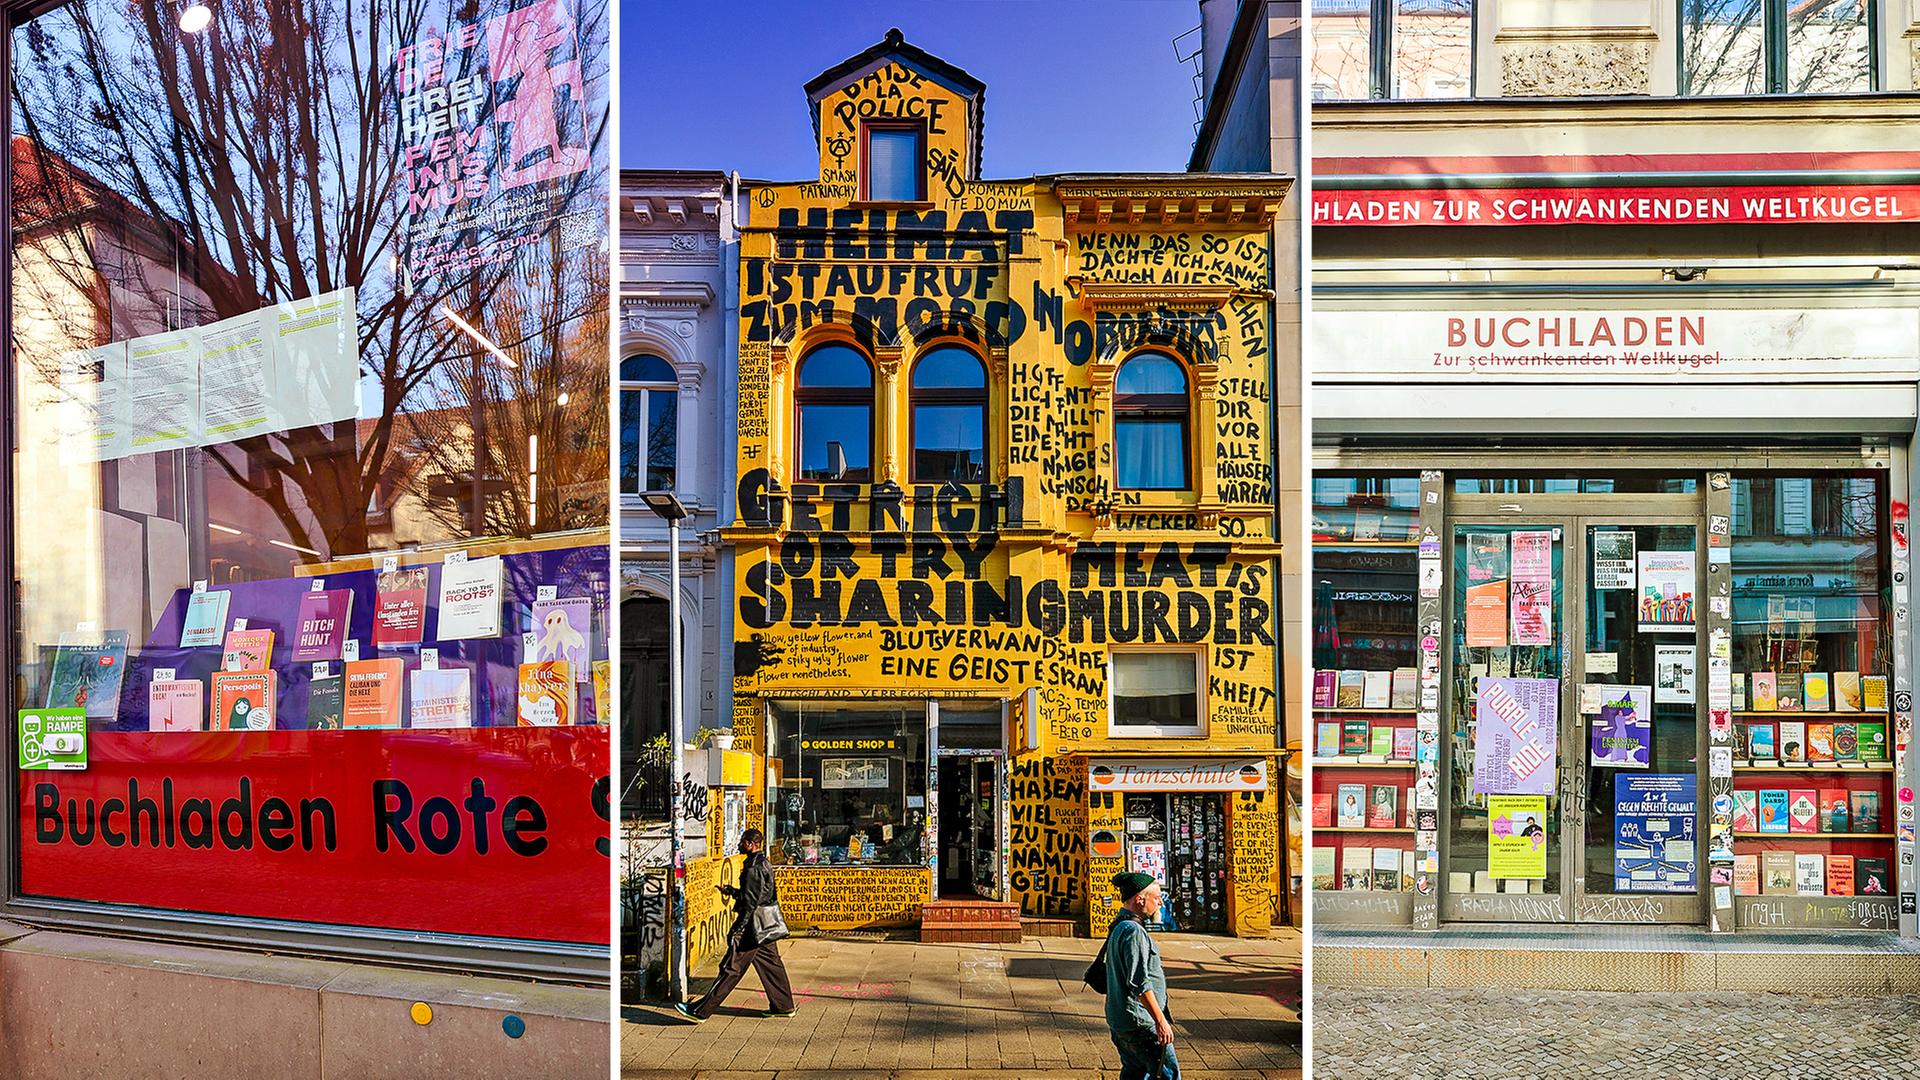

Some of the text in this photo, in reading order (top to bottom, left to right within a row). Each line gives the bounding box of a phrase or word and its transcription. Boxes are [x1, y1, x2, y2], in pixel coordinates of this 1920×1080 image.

[397, 24, 478, 67] FRIE
[401, 73, 484, 120] FREI
[876, 83, 903, 99] LA
[402, 97, 484, 142] HEIT
[834, 97, 950, 135] POLICE
[405, 126, 487, 168] FEM
[408, 151, 488, 192] INIS
[822, 167, 857, 182] SMASH
[409, 175, 489, 215] MUS
[797, 183, 858, 202] PATRIARCHY
[967, 183, 1024, 198] ROMANI
[972, 197, 1033, 213] DOMUM
[1431, 199, 1482, 221] ZUR
[1492, 197, 1731, 222] SCHWANKENDEN
[1742, 194, 1903, 219] WELTKUGEL
[777, 207, 1035, 261] HEIMAT
[1077, 231, 1230, 255] WENN DAS SO
[1079, 248, 1165, 271] DACHTE
[740, 299, 835, 343] ZUM
[1446, 315, 1706, 349] BUCHLADEN
[757, 366, 768, 374] ZU
[1432, 351, 1721, 368] Zur schwankenden Weltkugel
[1218, 377, 1269, 403] STELL
[739, 409, 764, 419] GENDE
[1216, 399, 1253, 420] DIR
[1216, 421, 1261, 441] VOR
[1216, 442, 1262, 461] ALLE
[737, 467, 861, 532] GET
[1116, 513, 1199, 532] WECKER
[1712, 525, 1727, 533] OK
[780, 531, 1001, 581] OR TRY
[1069, 541, 1268, 597] MEAT IS
[445, 590, 495, 604] ROOTS?
[446, 588, 467, 596] BACK
[738, 560, 1067, 639] SHARING
[302, 618, 335, 633] BITCH
[1067, 589, 1275, 646] MURDER
[300, 633, 331, 647] HUNT
[788, 629, 873, 647] yellow and
[789, 644, 798, 656] of
[1215, 647, 1255, 671] IST
[787, 653, 870, 669] spiky ugly flower
[223, 682, 262, 692] Persepolis
[734, 678, 754, 689] Star
[757, 669, 790, 685] Flower
[881, 656, 941, 679] EINE
[1208, 673, 1276, 713] KHEIT
[761, 688, 852, 698] DEUTSCHLAND
[860, 688, 936, 698] VERRECKE
[1481, 681, 1540, 742] PURPLE
[46, 722, 84, 733] RAMPE
[811, 739, 886, 750] GOLDEN SHOP
[1011, 755, 1055, 778] WIR
[1507, 735, 1552, 782] RIDE
[1118, 763, 1236, 786] Tanzschule
[1010, 777, 1084, 803] HABEN
[34, 776, 549, 857] Buchladen Rote
[1011, 804, 1057, 826] VIEL
[1641, 801, 1667, 812] RECHTE
[1010, 824, 1087, 855] ZU TUN
[786, 885, 819, 894] KLEINEN
[868, 903, 902, 913] GEWALT
